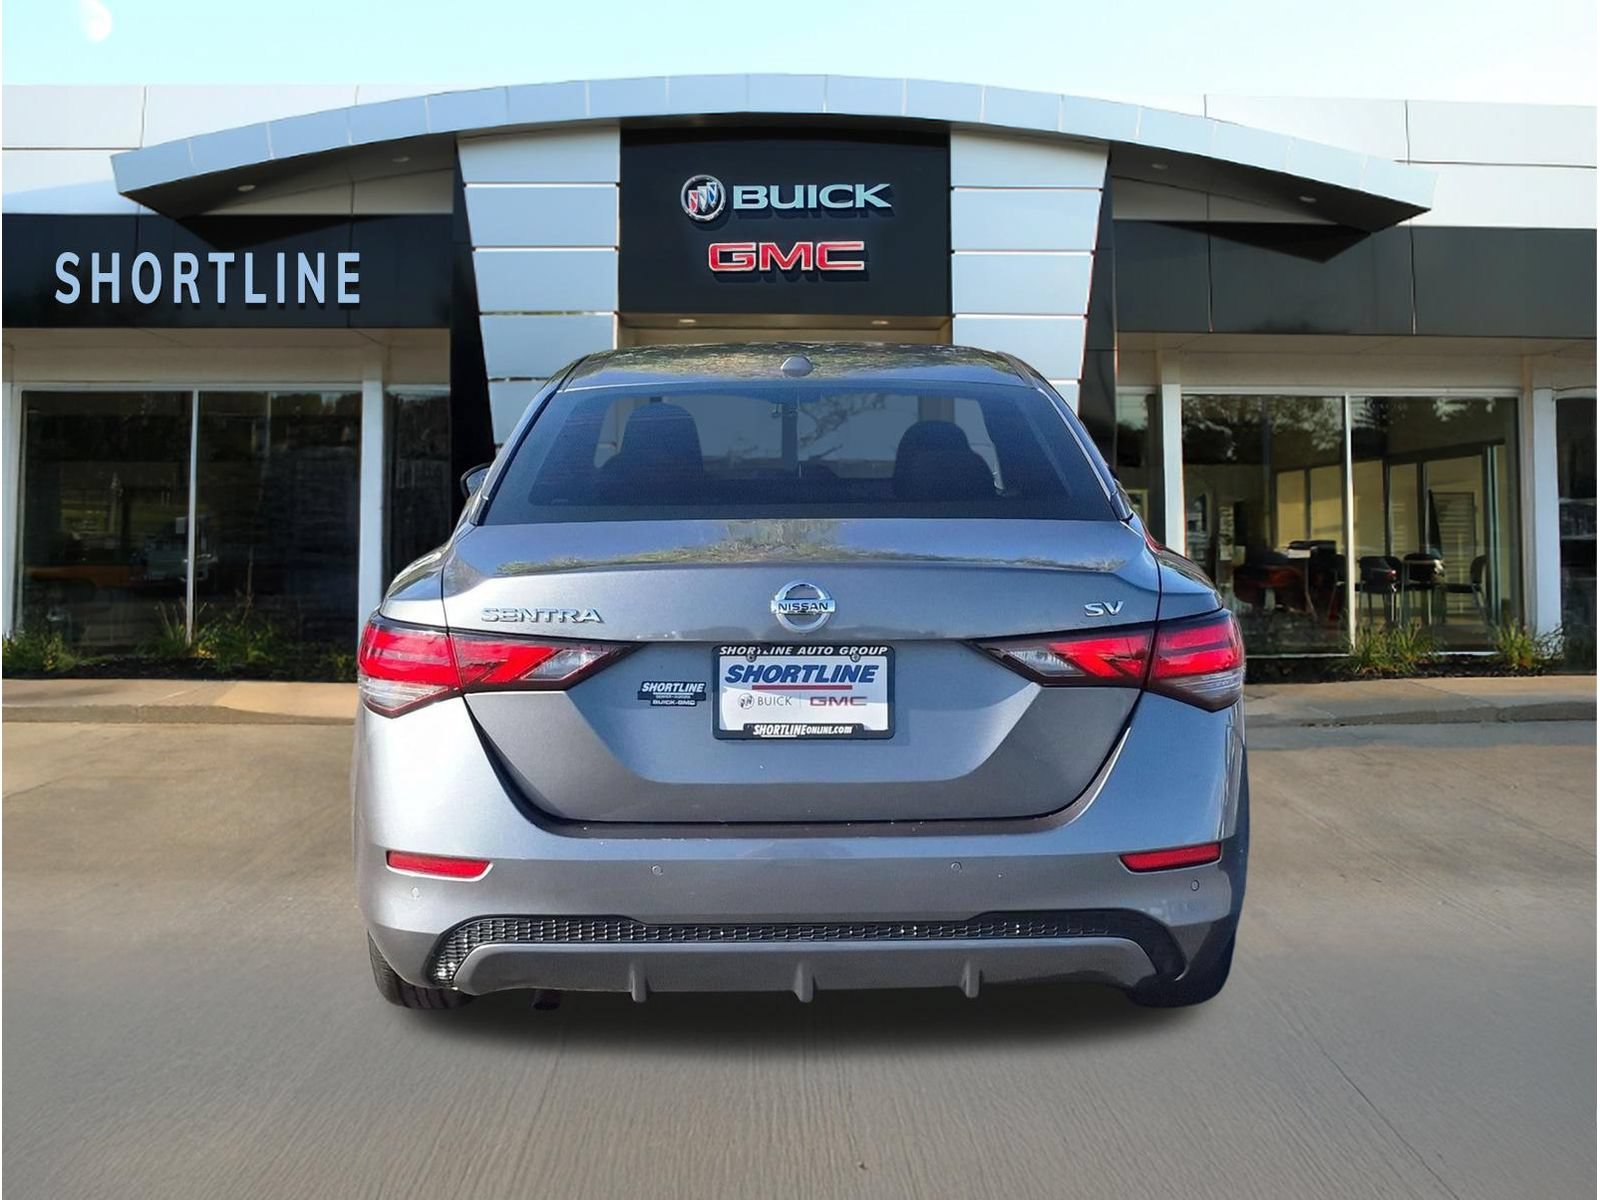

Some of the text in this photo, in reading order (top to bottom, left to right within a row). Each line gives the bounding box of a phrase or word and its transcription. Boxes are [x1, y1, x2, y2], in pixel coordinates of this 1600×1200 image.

[732, 183, 893, 210] BUICK
[708, 240, 865, 272] GMC
[54, 251, 361, 305] SHORTLINE
[480, 607, 605, 624] SENTRA
[778, 602, 829, 612] NISSAN
[1083, 600, 1124, 617] SV
[797, 646, 834, 656] AUTO
[838, 646, 888, 656] GROUP
[724, 664, 879, 684] SHORTLINE
[641, 682, 705, 693] SHORTLINE
[757, 696, 868, 707] BUICK GMC
